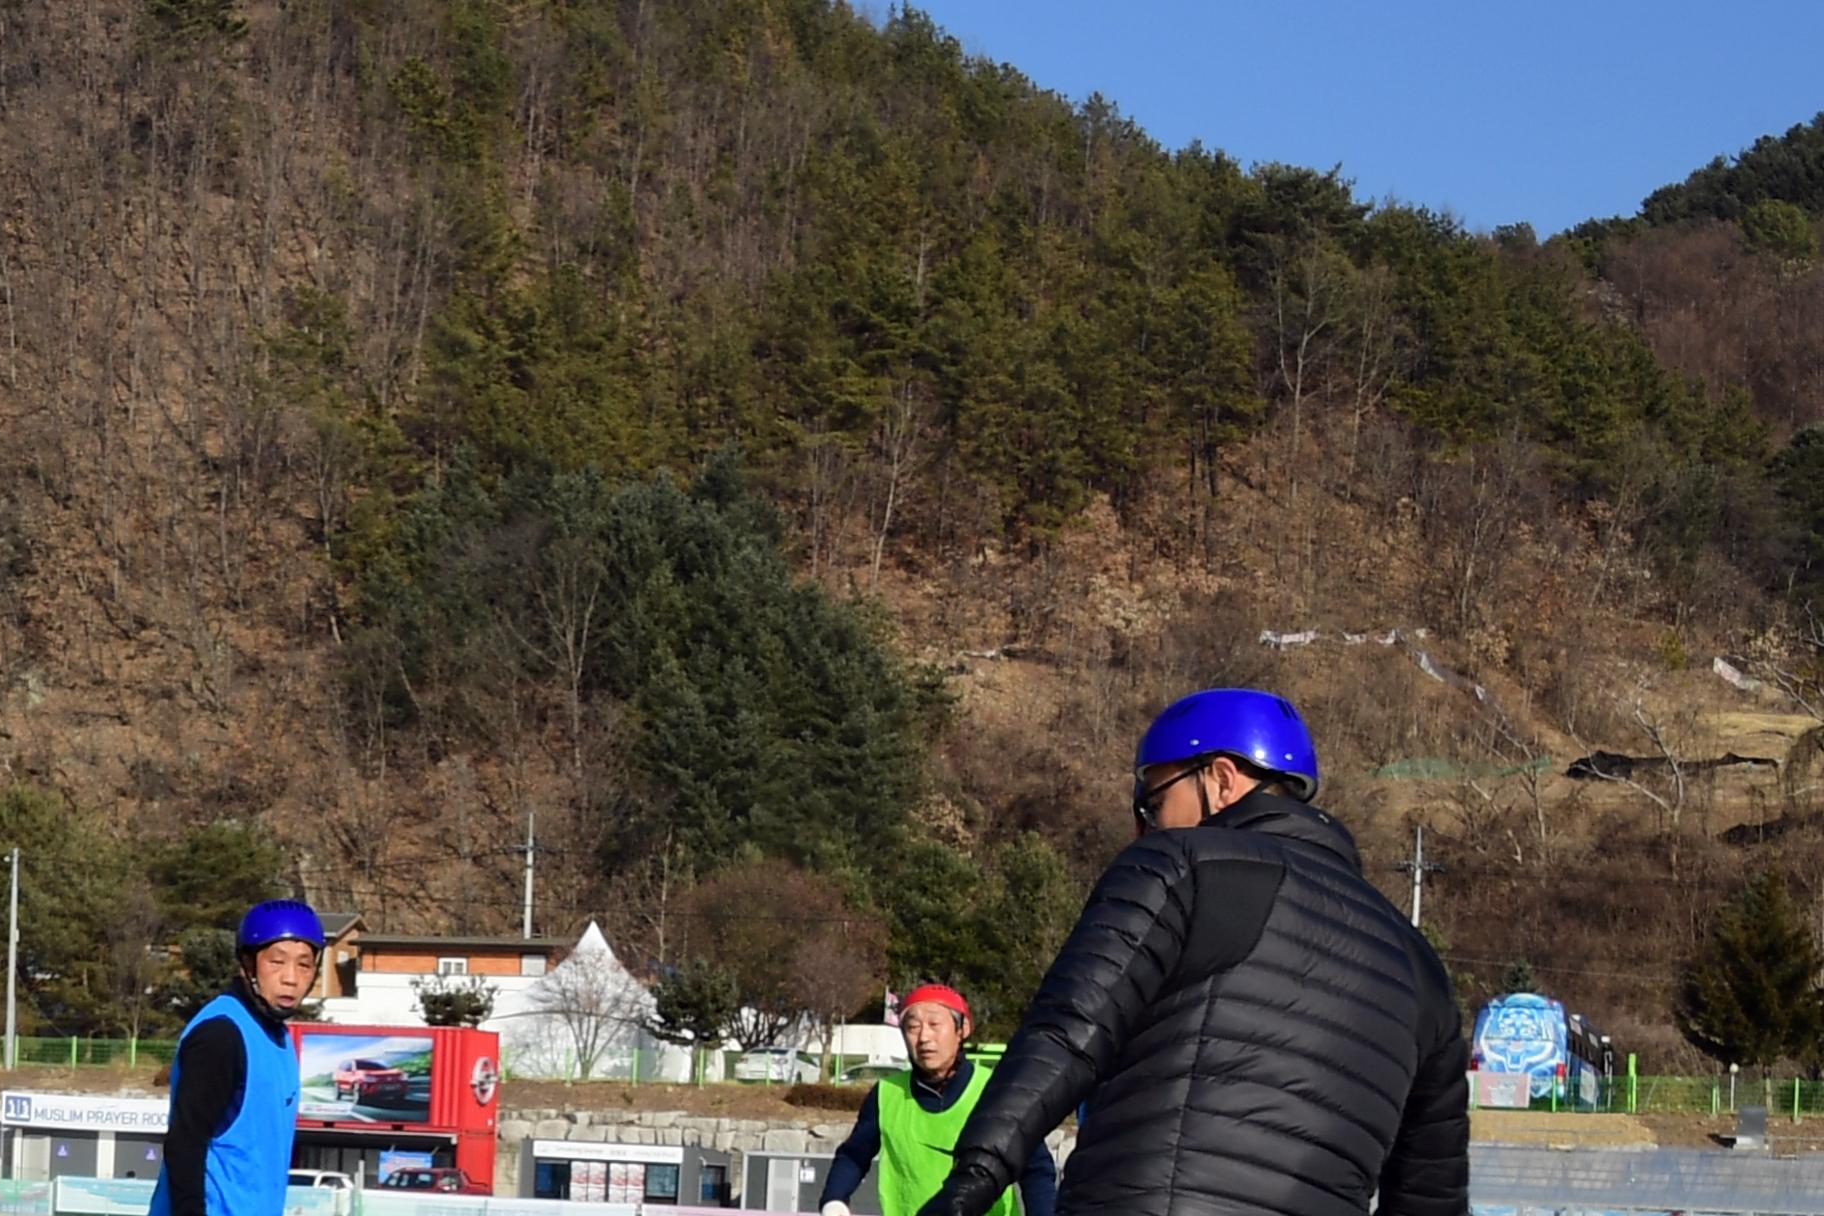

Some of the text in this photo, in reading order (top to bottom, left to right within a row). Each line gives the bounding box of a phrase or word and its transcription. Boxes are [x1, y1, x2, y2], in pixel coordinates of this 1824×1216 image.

[34, 1107, 169, 1127] MUSLIM PRAYER ROO
